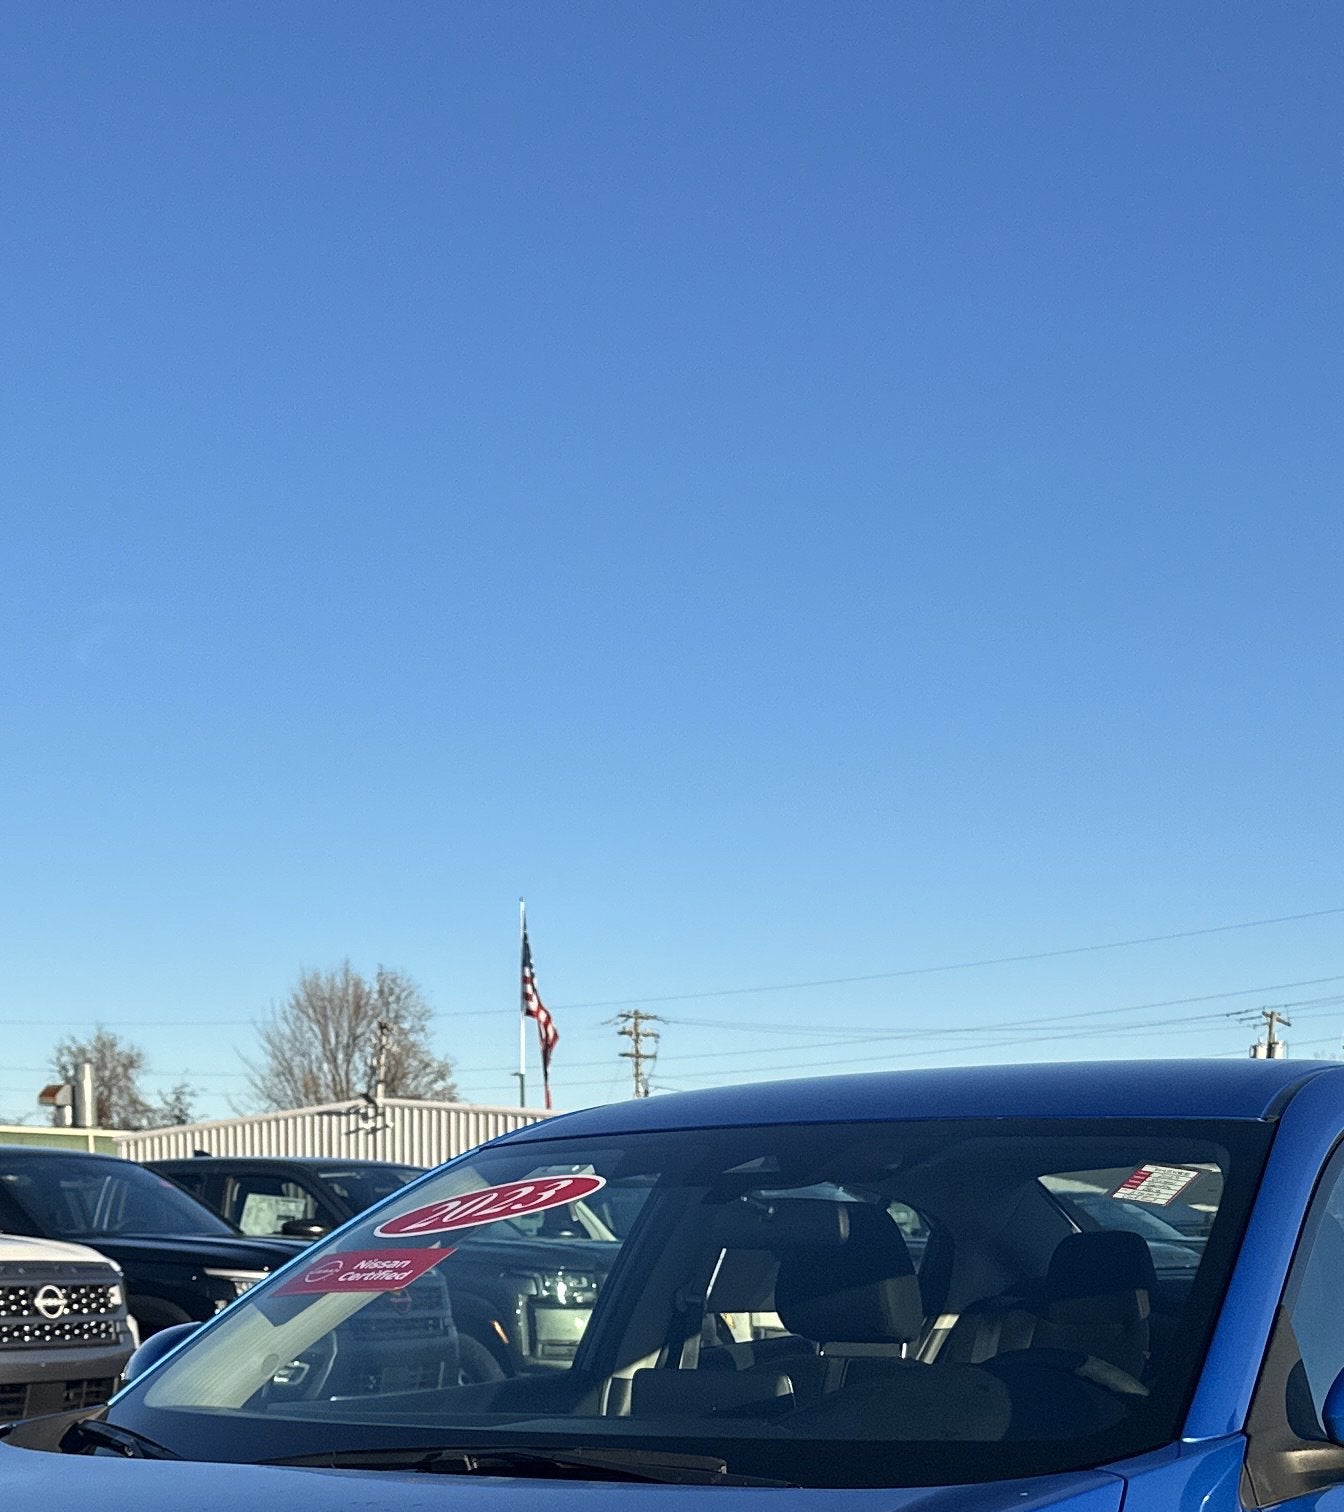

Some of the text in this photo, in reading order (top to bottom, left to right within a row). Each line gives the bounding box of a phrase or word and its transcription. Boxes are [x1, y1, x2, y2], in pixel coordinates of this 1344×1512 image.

[399, 1179, 574, 1233] 2023
[353, 1258, 412, 1270] Nissan
[337, 1269, 414, 1282] Certified
